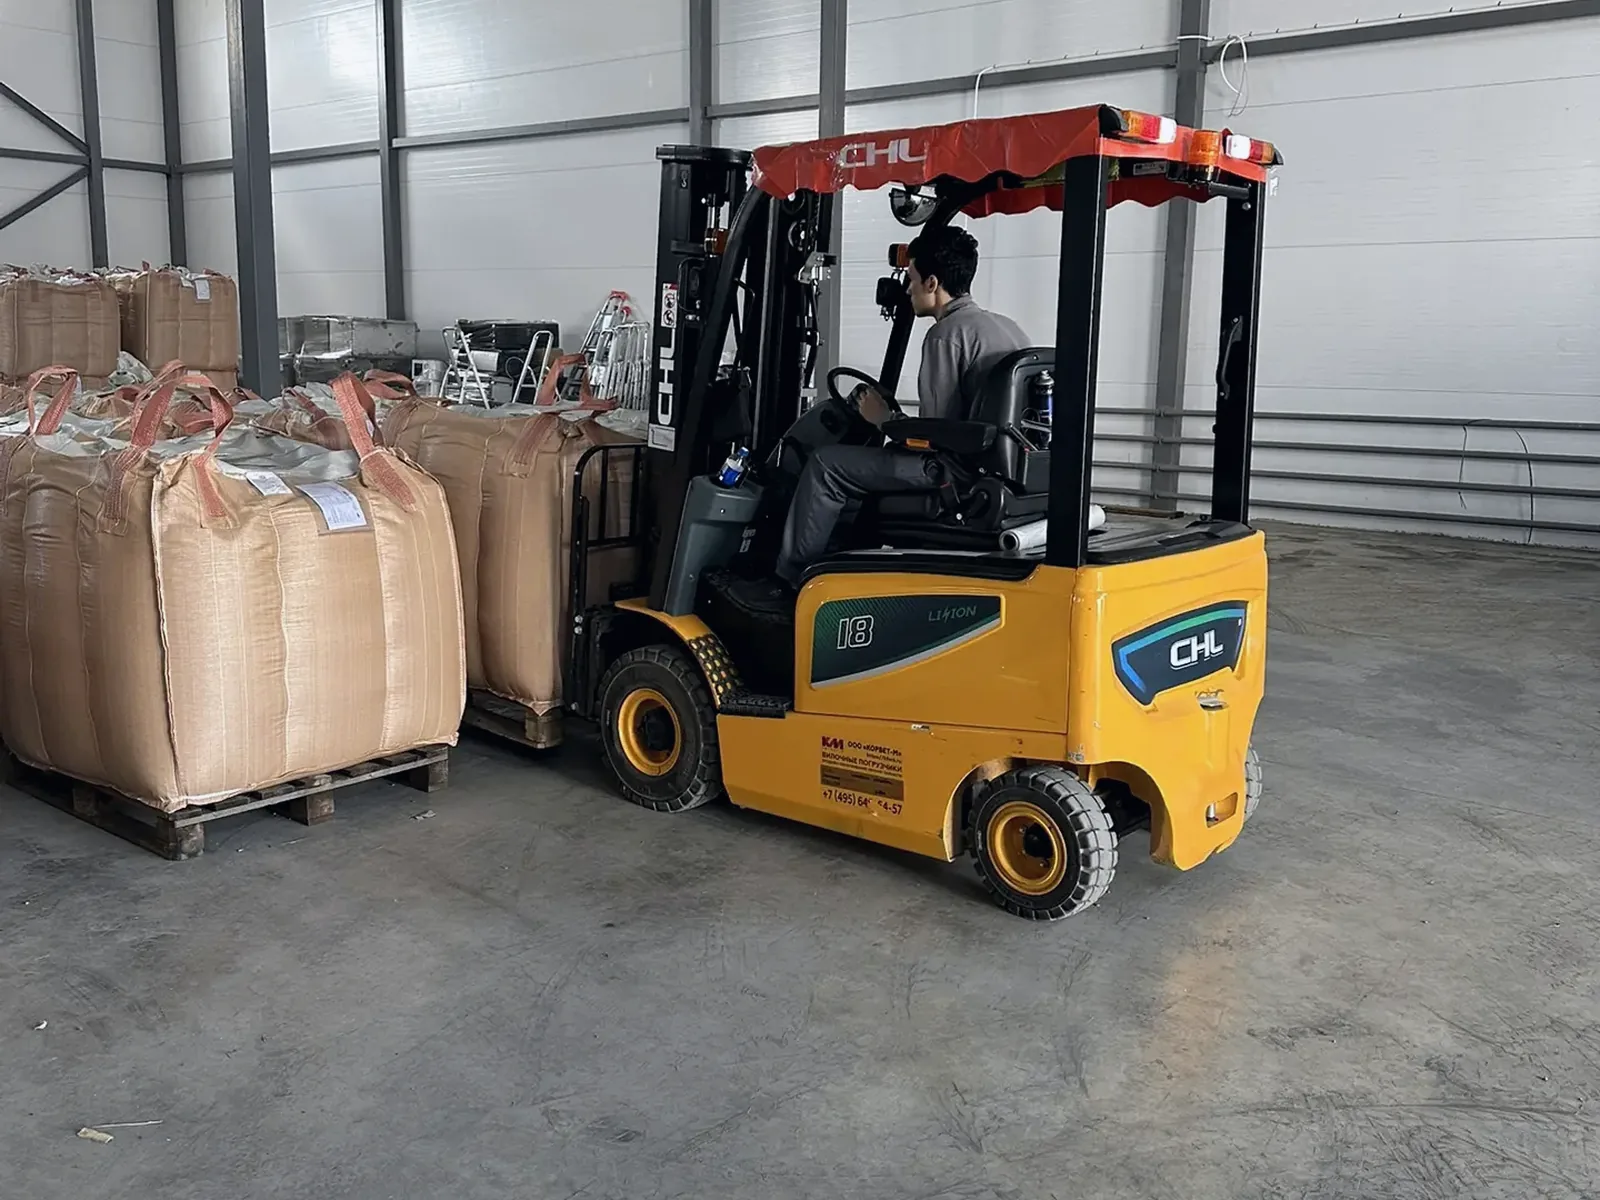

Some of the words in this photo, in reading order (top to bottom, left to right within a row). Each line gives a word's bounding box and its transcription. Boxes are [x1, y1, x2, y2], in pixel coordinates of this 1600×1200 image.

[838, 138, 927, 168] CHL
[658, 327, 676, 426] CHL
[836, 614, 874, 650] 18
[1170, 629, 1224, 670] CHL
[834, 789, 857, 806] (495)
